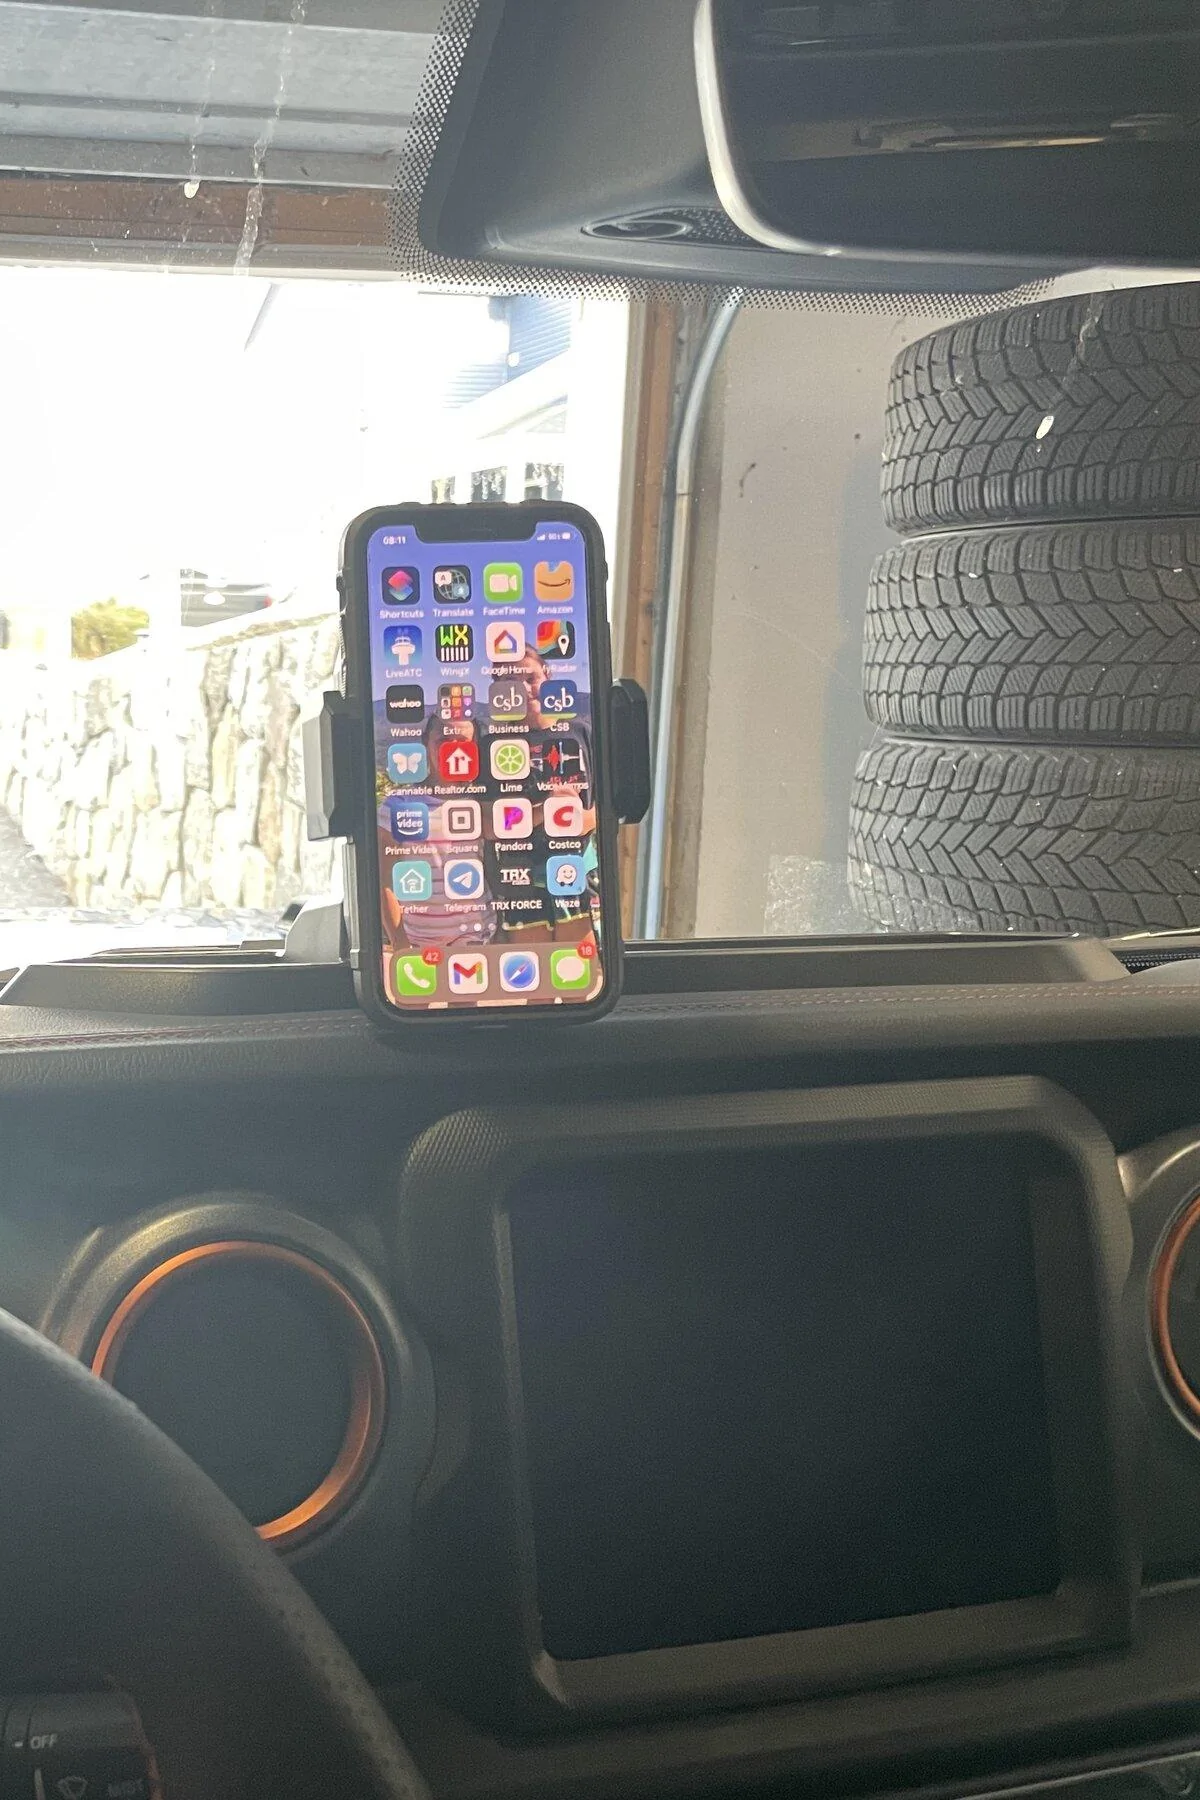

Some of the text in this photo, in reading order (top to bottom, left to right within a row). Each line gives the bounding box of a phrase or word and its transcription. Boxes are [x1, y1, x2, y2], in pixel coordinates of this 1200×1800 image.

[379, 609, 425, 619] Shortcuts
[433, 608, 474, 617] Translate
[483, 606, 526, 616] FaceTime
[537, 605, 574, 615] Amazon
[440, 625, 469, 646] WX
[385, 668, 423, 679] LiveATC
[481, 665, 509, 677] Google
[537, 664, 578, 676] yRadar
[390, 727, 422, 738] Wahoo
[488, 725, 530, 734] Business
[550, 723, 570, 732] CSB
[385, 786, 433, 797] Scannable
[434, 784, 487, 795] Realtor.com
[500, 783, 523, 793] Lime
[396, 809, 423, 820] prime
[397, 817, 423, 828] video
[385, 845, 411, 856] Prime
[495, 841, 533, 852] Pandora
[548, 840, 582, 850] Costco
[400, 904, 429, 914] Tether
[444, 903, 487, 913] Telegram
[491, 899, 543, 911] TRX FORCE
[425, 952, 439, 962] 42
[29, 1733, 58, 1750] OFF
